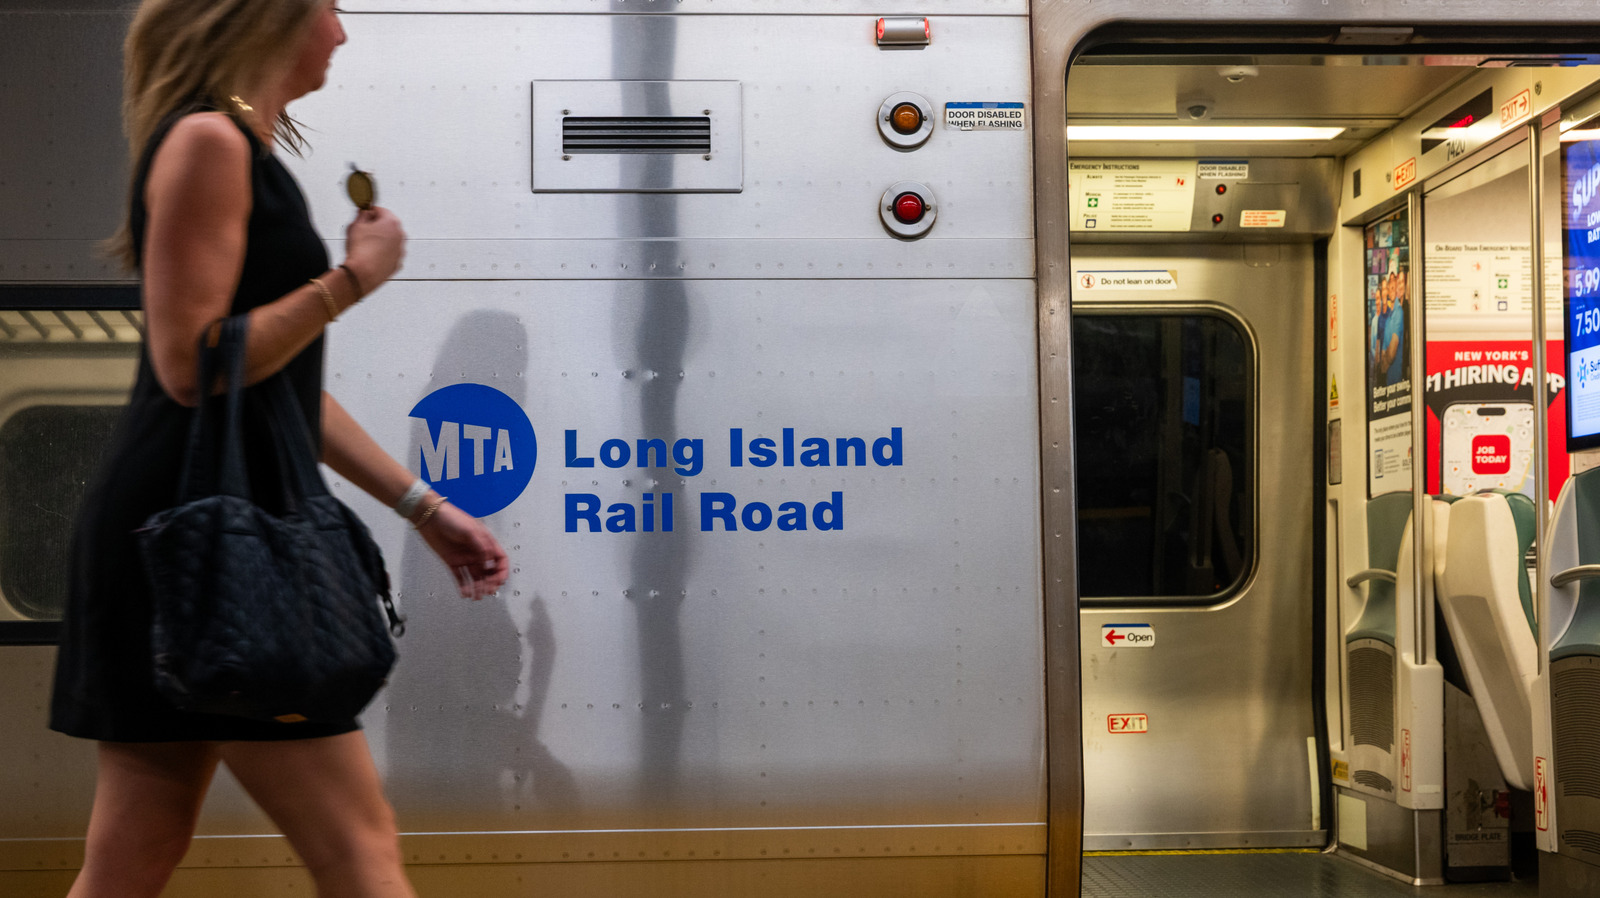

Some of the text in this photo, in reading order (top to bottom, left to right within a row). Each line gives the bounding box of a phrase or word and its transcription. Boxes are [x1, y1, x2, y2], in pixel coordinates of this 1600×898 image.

[948, 111, 1022, 119] DOOR DISABLED
[1501, 100, 1518, 124] EXIT
[948, 120, 1022, 128] WHEN FLASHING
[1446, 139, 1466, 162] 7420
[1401, 162, 1414, 183] EXIT
[1575, 267, 1600, 297] 5.99
[1575, 307, 1600, 337] 7.50
[1454, 351, 1529, 361] NEW YORK'S
[1444, 364, 1519, 389] HIRING
[1520, 366, 1566, 393] AP
[1373, 386, 1387, 399] Better
[1386, 383, 1397, 397] your
[1373, 401, 1387, 413] Better
[1386, 399, 1397, 412] your
[409, 416, 514, 483] MTA
[564, 427, 904, 477] Long Island
[1476, 446, 1495, 454] JOB
[1475, 455, 1507, 463] TODAY
[564, 491, 845, 533] Rail Road
[1127, 633, 1153, 643] Open
[1110, 717, 1146, 730] EXIT
